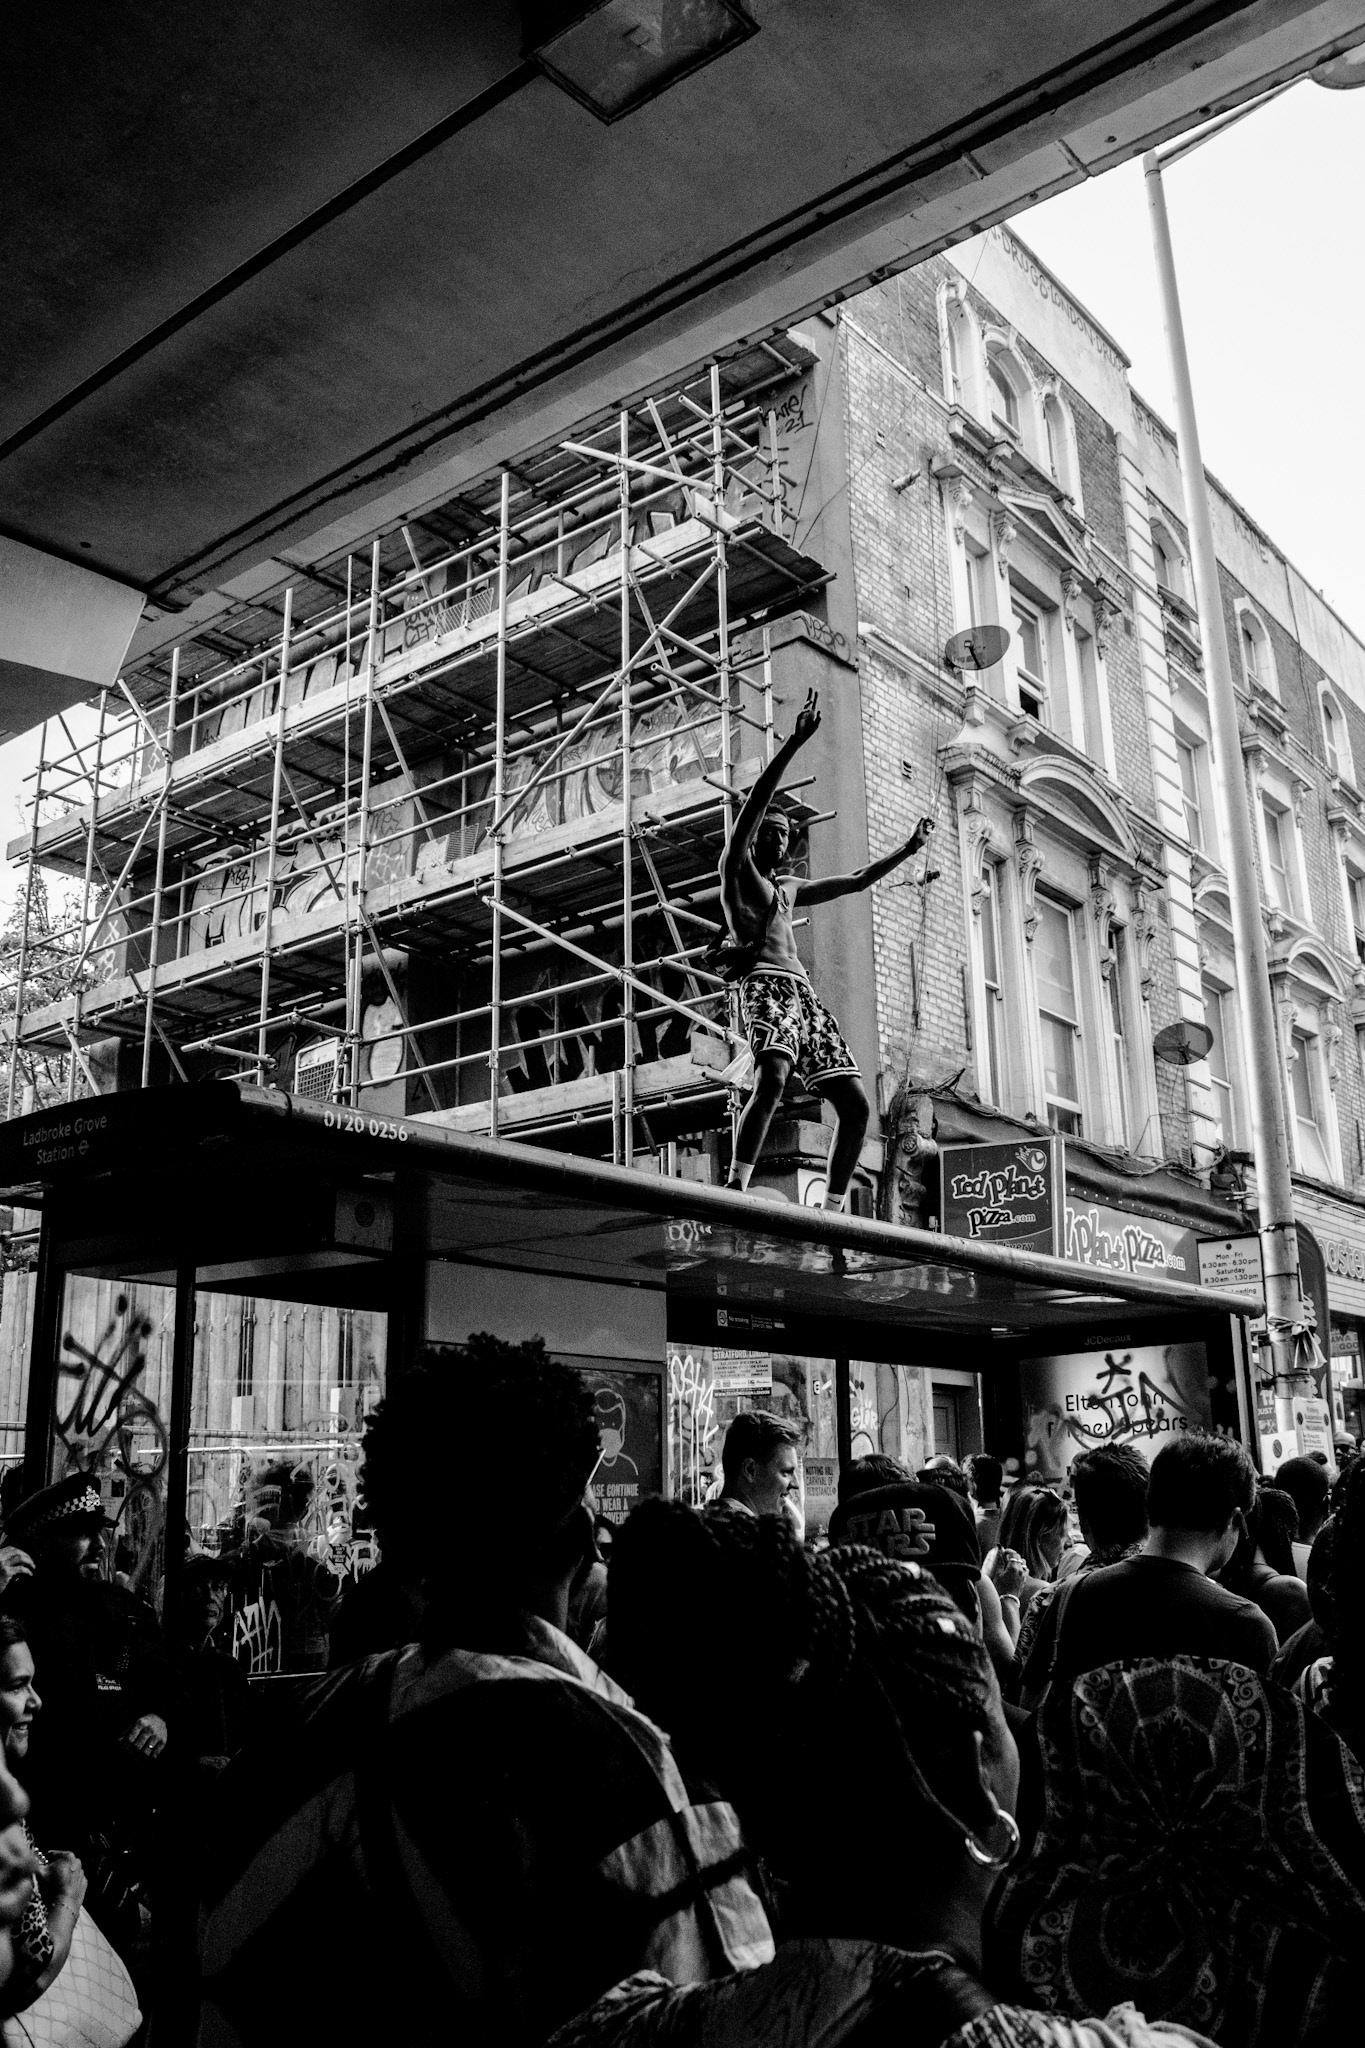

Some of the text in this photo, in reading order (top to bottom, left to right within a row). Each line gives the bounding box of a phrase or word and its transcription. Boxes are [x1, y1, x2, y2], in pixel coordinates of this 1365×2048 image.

[23, 1115, 107, 1147] Ladbroke Grove
[323, 1110, 408, 1141] 0120 0256
[36, 1145, 75, 1165] Station
[951, 1164, 1046, 1207] red planet
[1216, 1267, 1246, 1275] Saturday
[1084, 1333, 1132, 1346] JCDecaux
[607, 1483, 639, 1497] CONTINUE
[602, 1497, 622, 1511] WEAR
[623, 1497, 629, 1511] A
[841, 1507, 936, 1542] STAR
